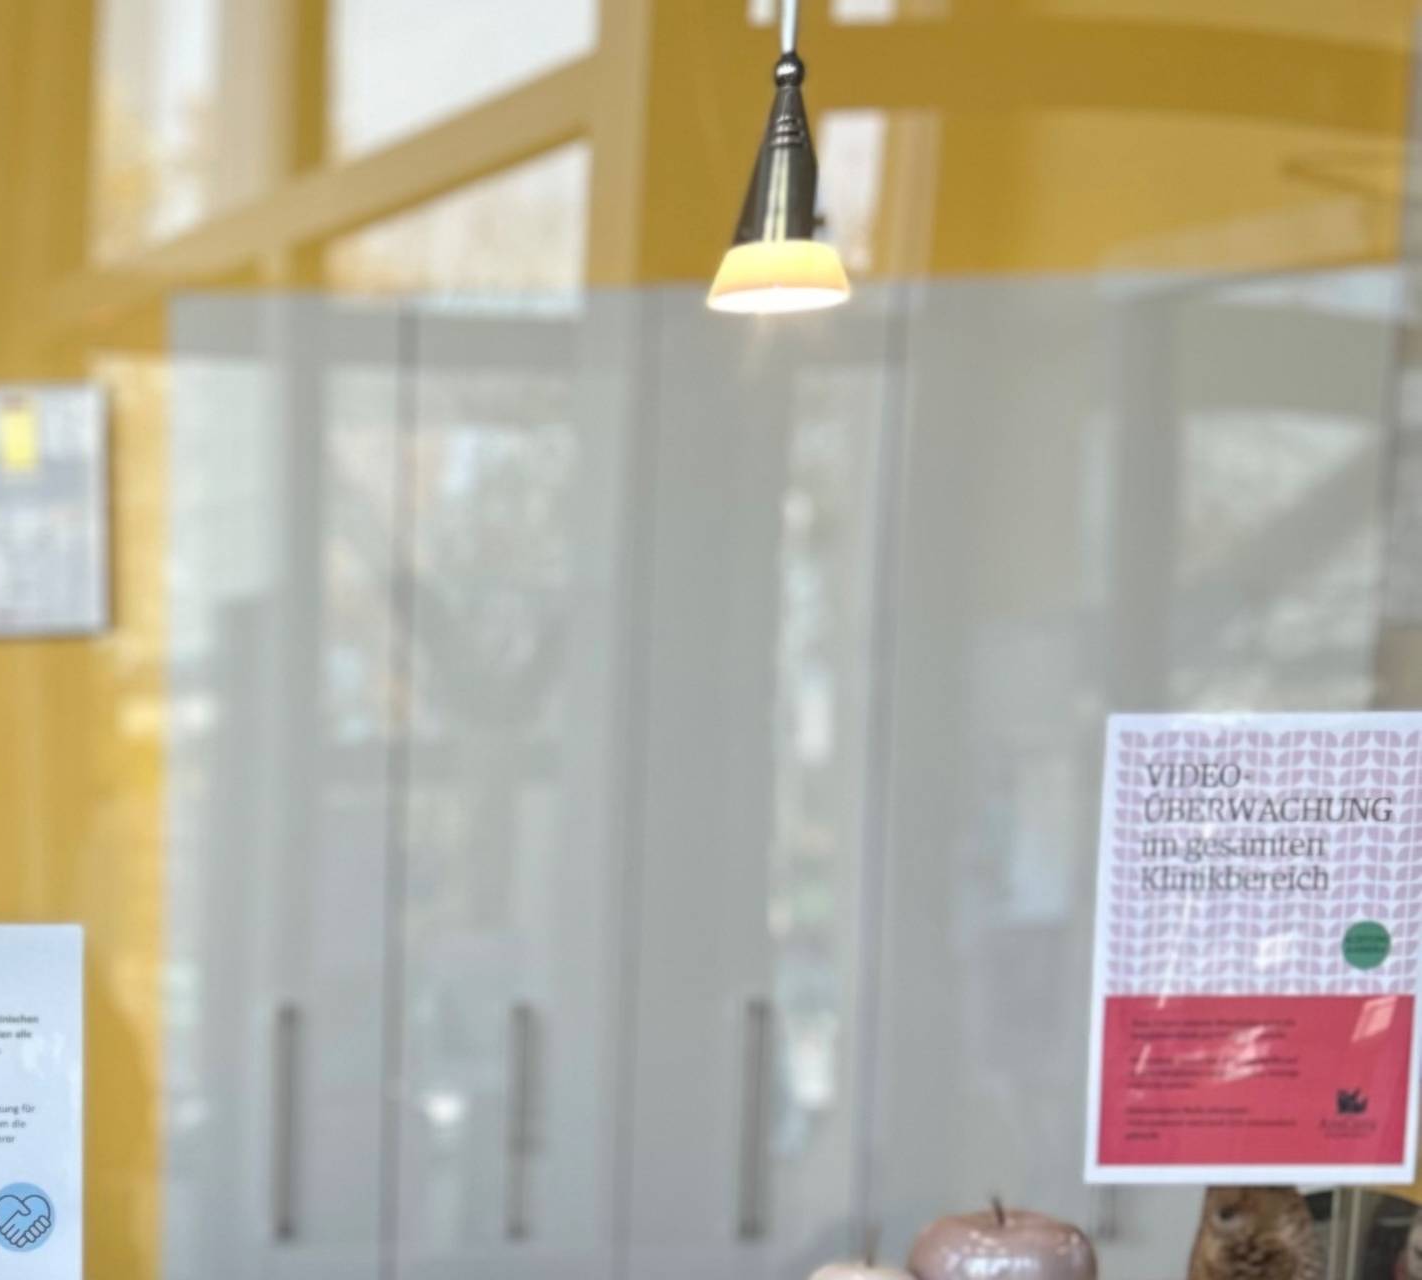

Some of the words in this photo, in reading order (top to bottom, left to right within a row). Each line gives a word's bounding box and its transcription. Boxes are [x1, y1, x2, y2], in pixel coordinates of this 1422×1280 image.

[1147, 763, 1251, 788] VIDEO-
[1143, 795, 1394, 823] ÜBERWACHUNG
[1141, 834, 1178, 858] im
[1185, 835, 1326, 863] gesamten
[1140, 864, 1330, 893] Klinikbereich
